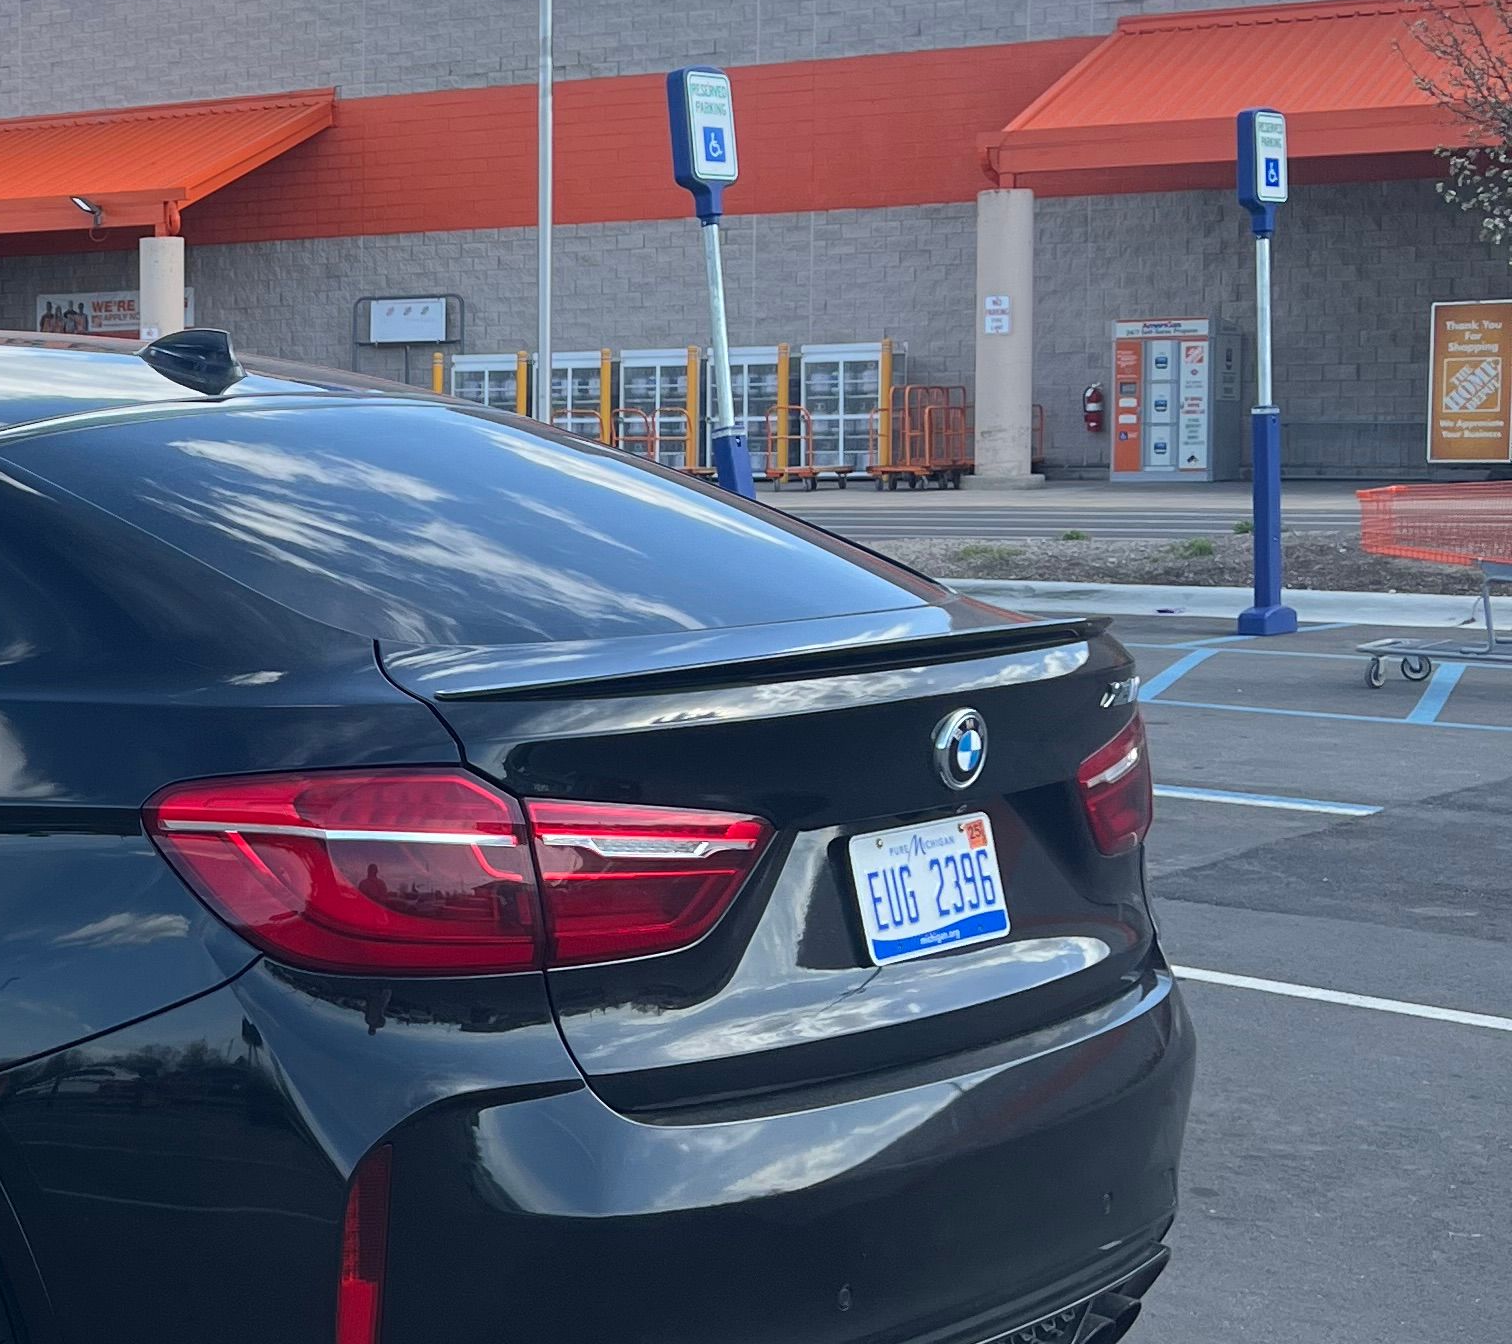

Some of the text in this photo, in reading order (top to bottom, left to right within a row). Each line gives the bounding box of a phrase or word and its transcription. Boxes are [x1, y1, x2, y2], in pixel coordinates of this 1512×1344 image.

[689, 83, 727, 98] RESERVED
[695, 100, 726, 116] PARKING
[92, 300, 136, 313] WE'RE
[1445, 320, 1503, 331] Thank You
[1464, 331, 1483, 341] For
[1448, 341, 1499, 354] Shopping
[1444, 359, 1500, 411] HOME
[889, 844, 909, 857] PURE
[866, 849, 996, 931] EUG 2396
